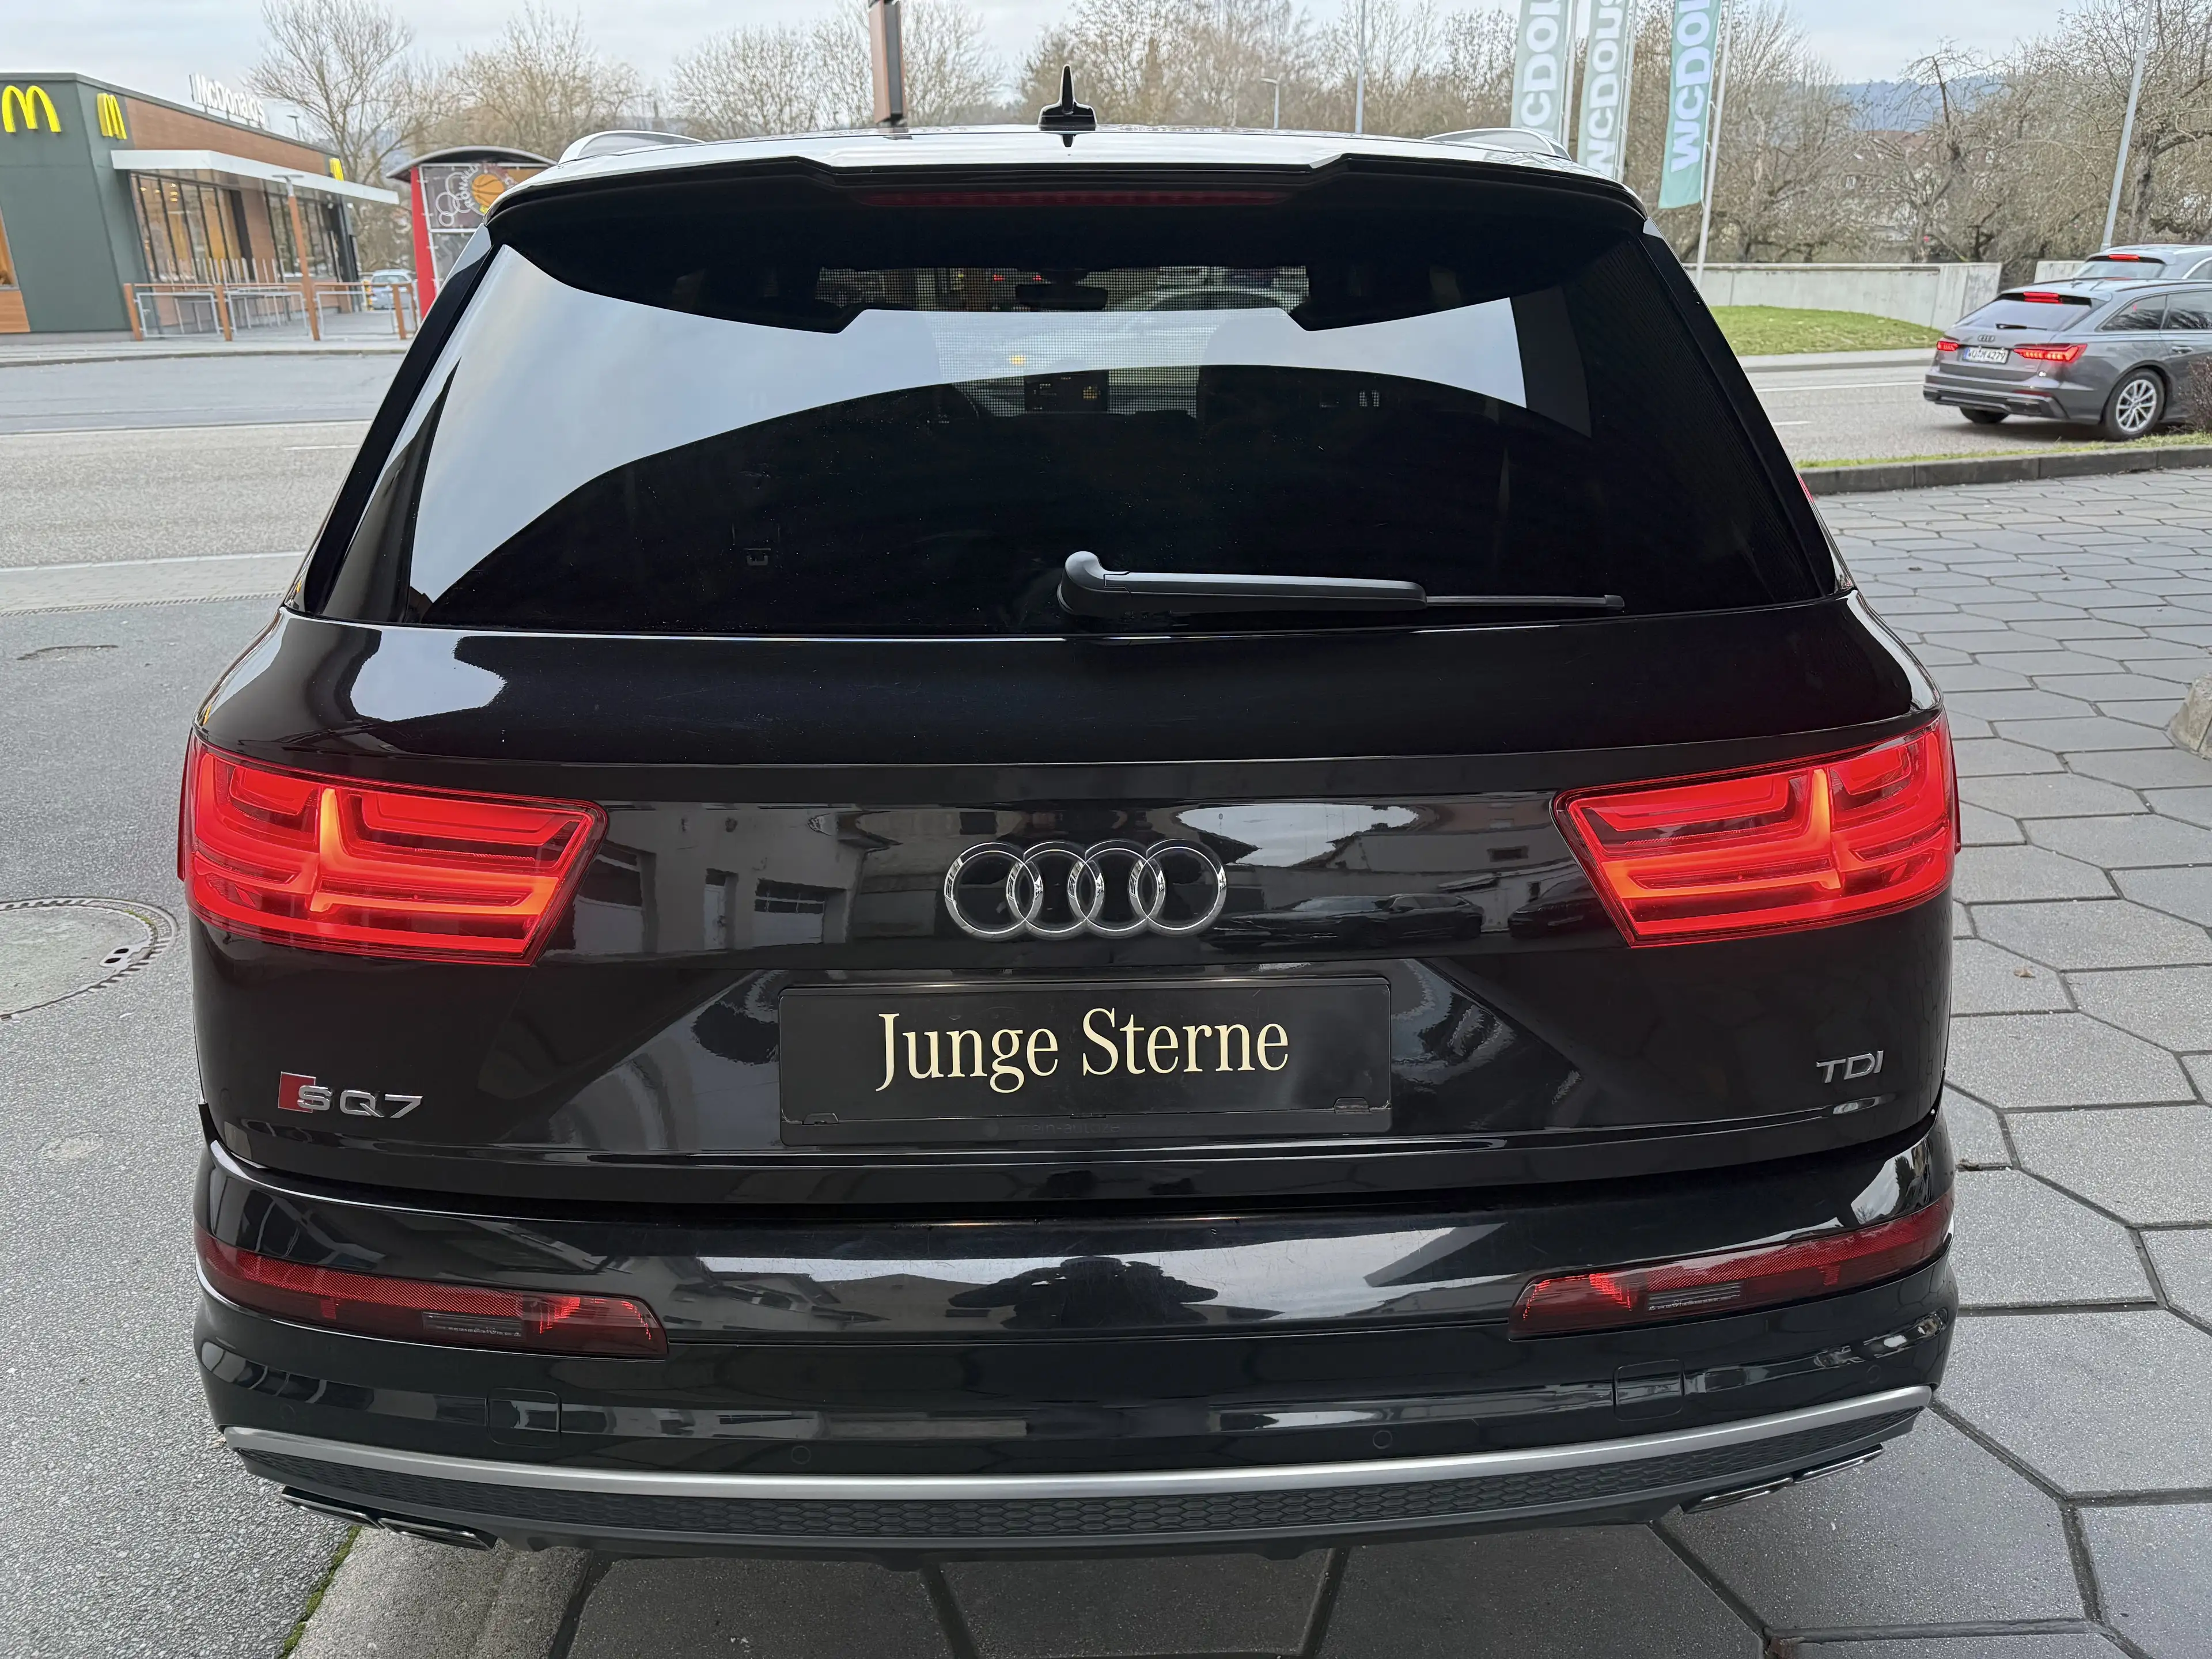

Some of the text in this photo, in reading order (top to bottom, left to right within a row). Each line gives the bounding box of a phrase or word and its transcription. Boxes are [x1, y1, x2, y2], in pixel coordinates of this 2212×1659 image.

[876, 1007, 1289, 1093] Junge Sterne
[1816, 1050, 1884, 1083] TDI
[297, 1085, 423, 1118] SQ7
